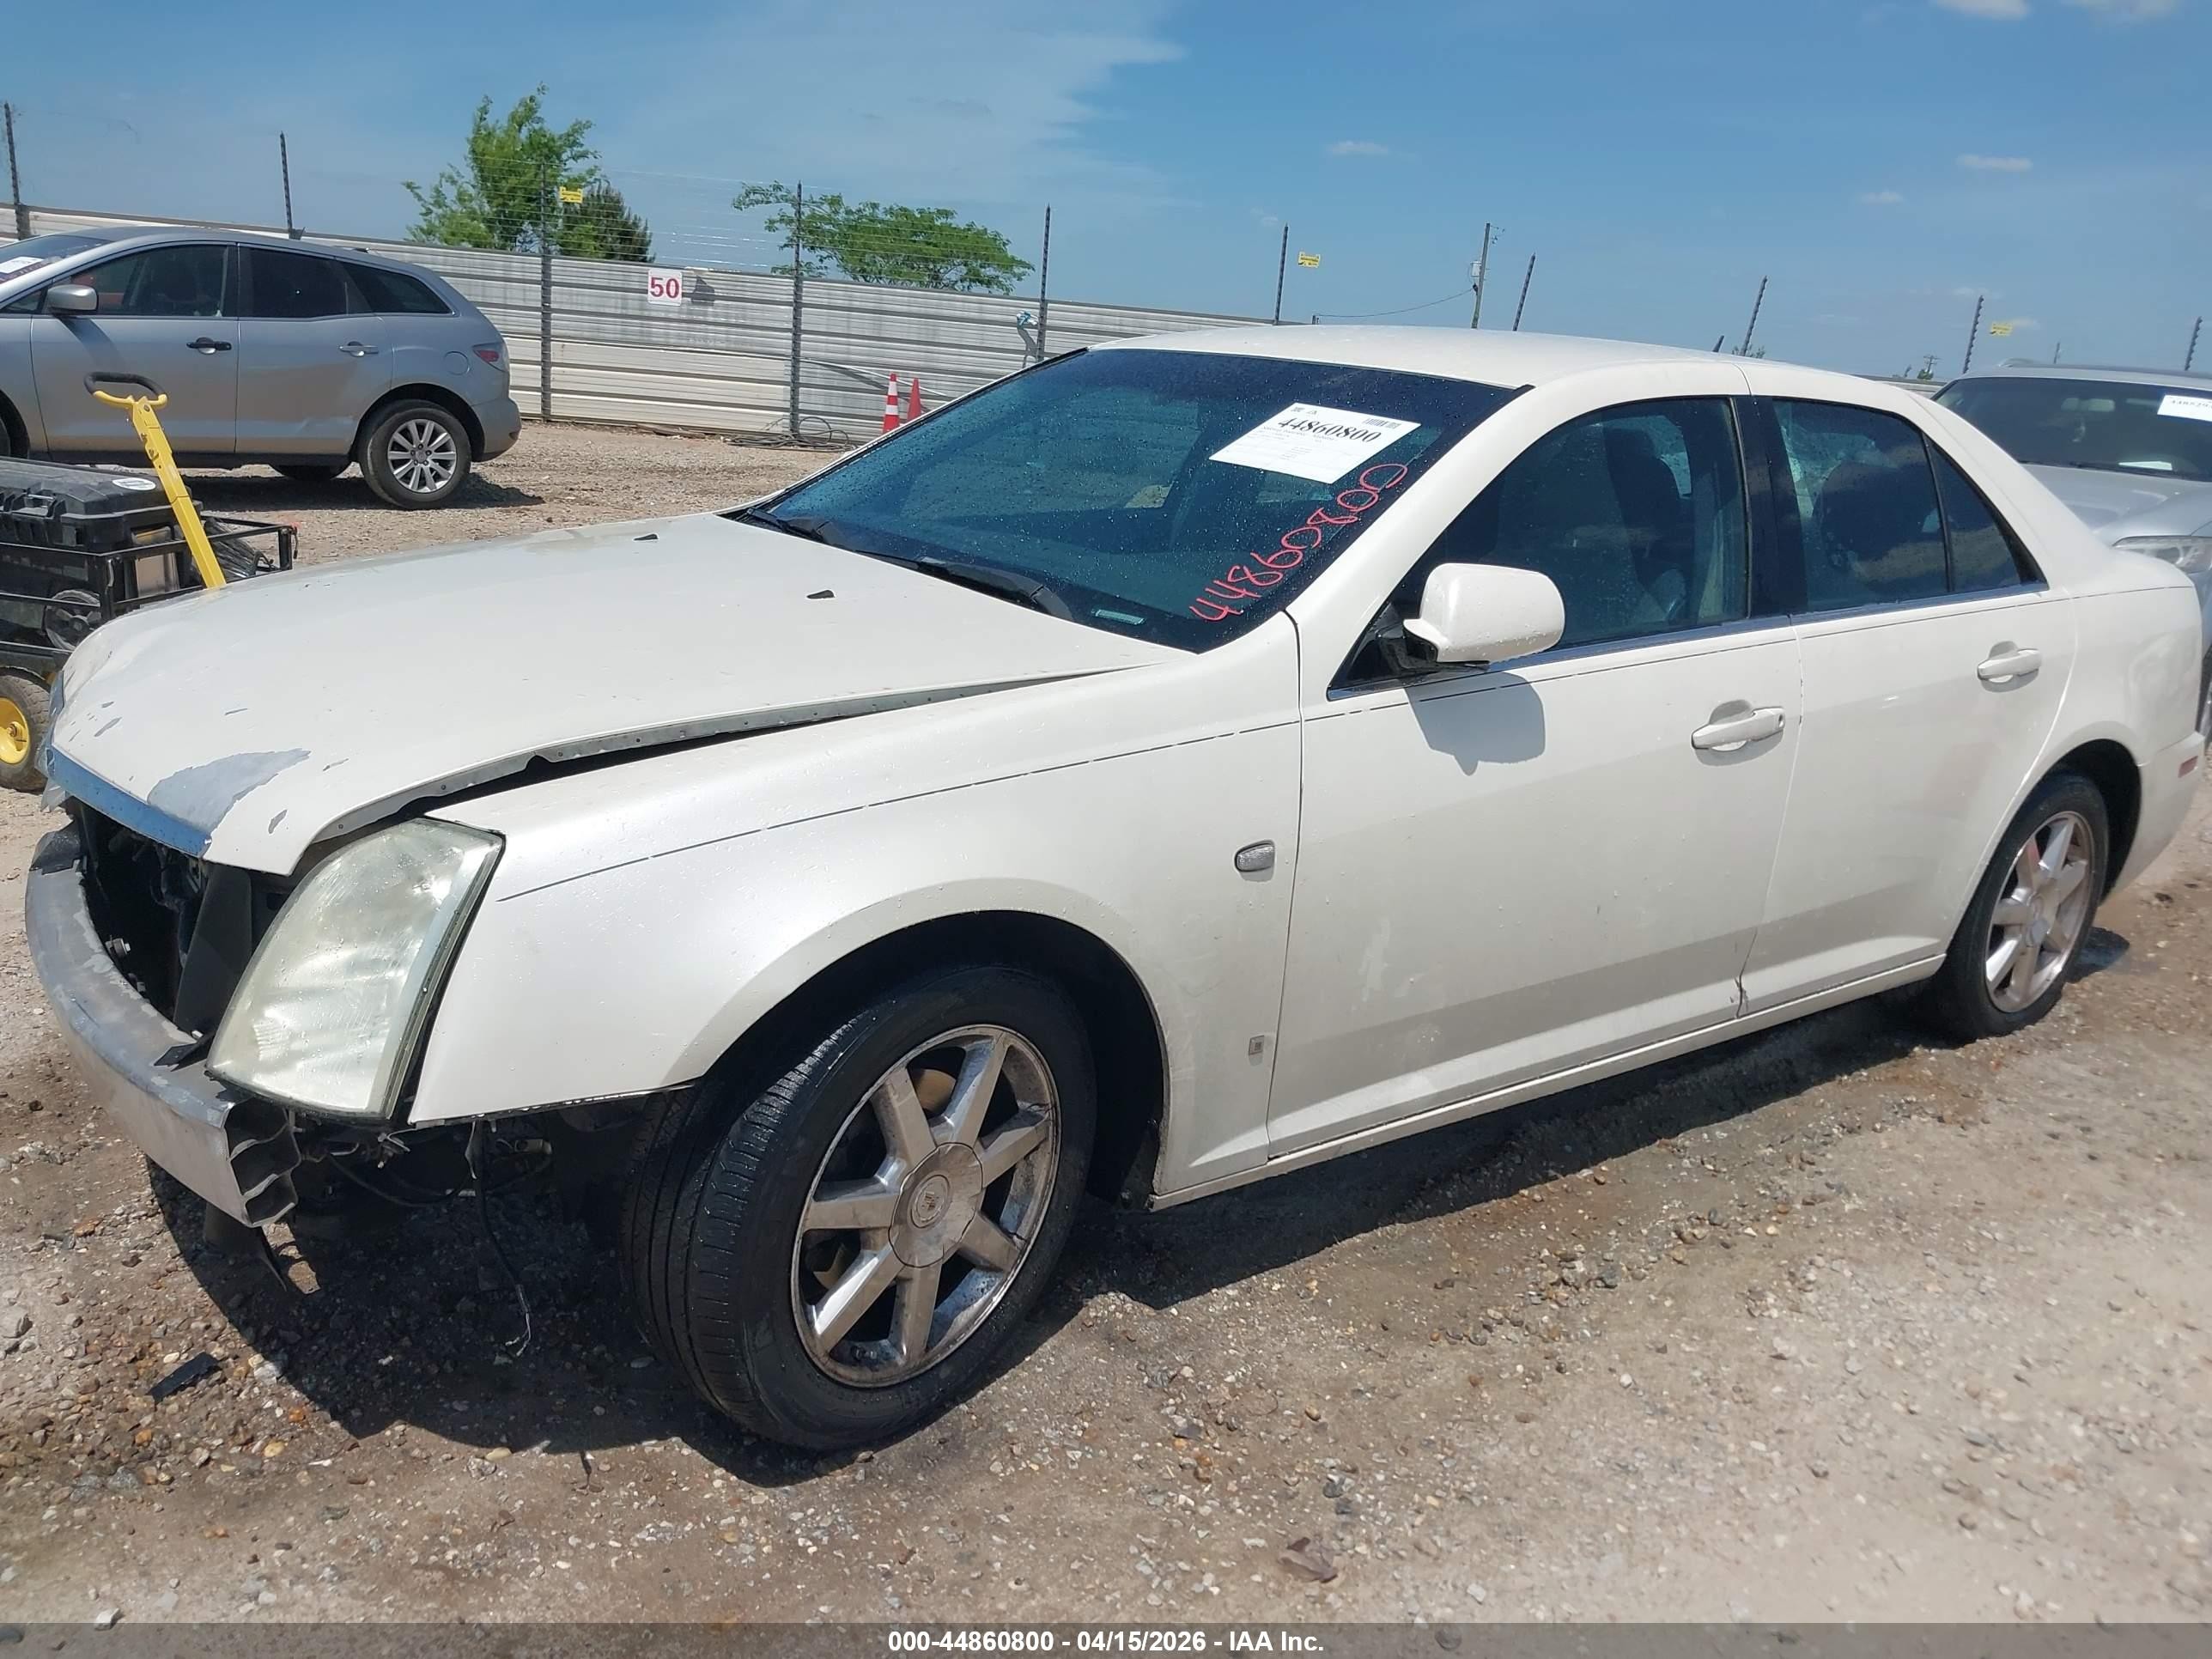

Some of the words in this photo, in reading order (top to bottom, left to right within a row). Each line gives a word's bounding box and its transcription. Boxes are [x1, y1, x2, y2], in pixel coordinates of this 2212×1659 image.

[650, 276, 679, 299] 50
[1278, 417, 1382, 442] 44860800
[1189, 463, 1408, 621] 44860800
